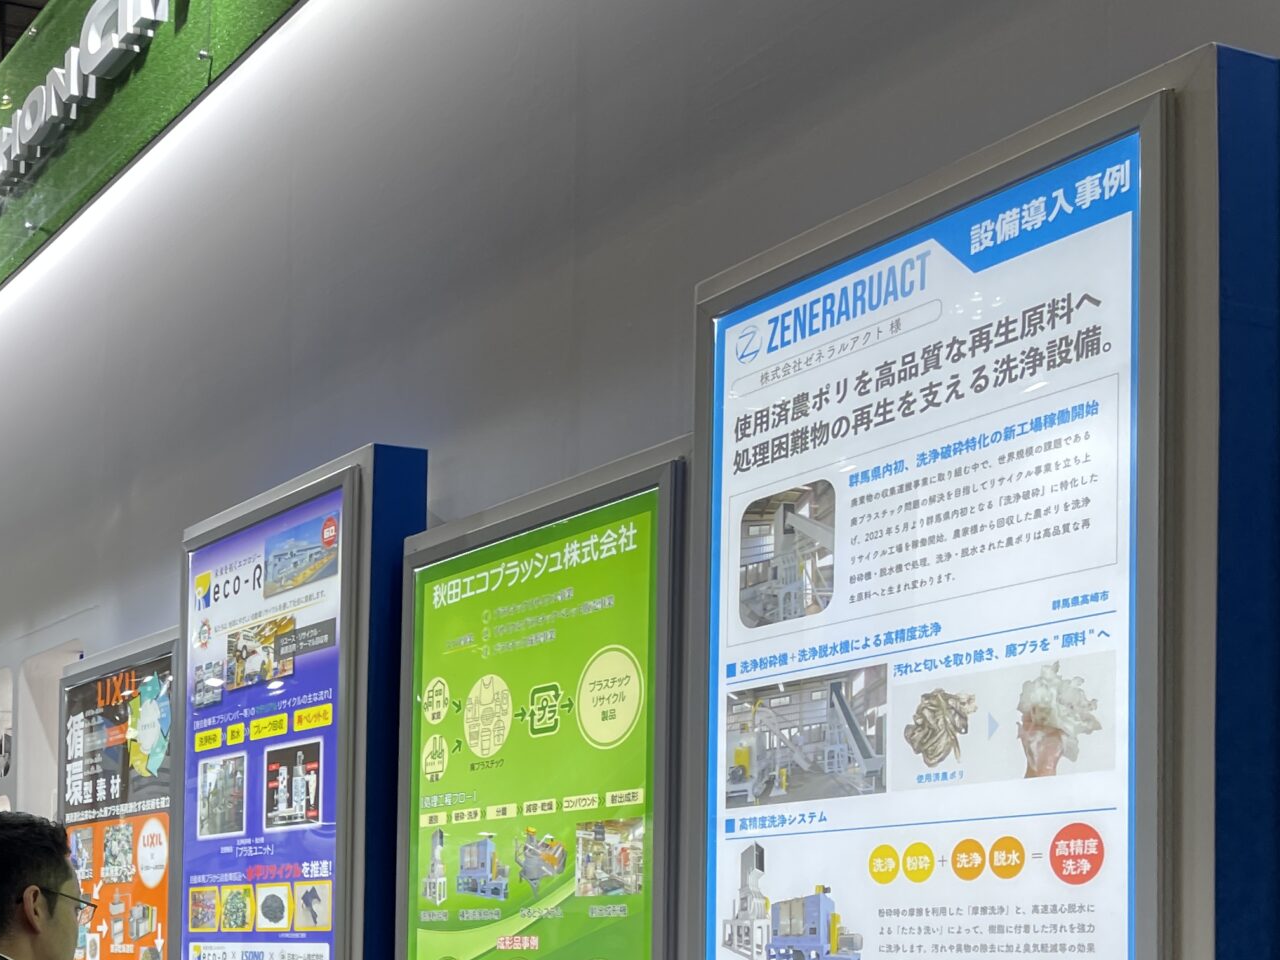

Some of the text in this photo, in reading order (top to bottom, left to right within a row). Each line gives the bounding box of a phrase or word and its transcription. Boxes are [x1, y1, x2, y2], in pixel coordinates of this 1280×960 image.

[969, 159, 1132, 255] 設備導入事例
[767, 250, 932, 354] ZENERARUACT
[734, 291, 1103, 442] 使用済農ポリを高品質な再生原料へ
[759, 317, 902, 386] 株式会社ゼネラルアクト 様
[733, 327, 1113, 475] 処理困難物の再生を支える洗浄設備。
[849, 400, 1099, 488] 群馬県内初、洗浄破砕特化の新工場稼働開始
[432, 522, 638, 609] 秋田エコプラッシュ株式会社
[213, 563, 263, 602] eco-R
[588, 674, 631, 692] プラスチック
[591, 693, 626, 707] リサイクル
[601, 709, 617, 722] 製品
[738, 811, 828, 831] 高精度洗浄システム
[142, 832, 163, 848] LIXIL
[1055, 838, 1099, 855] 高精度
[873, 850, 1020, 872] 洗浄 粉砕 洗浄 脱水
[1062, 859, 1092, 876] 洗浄
